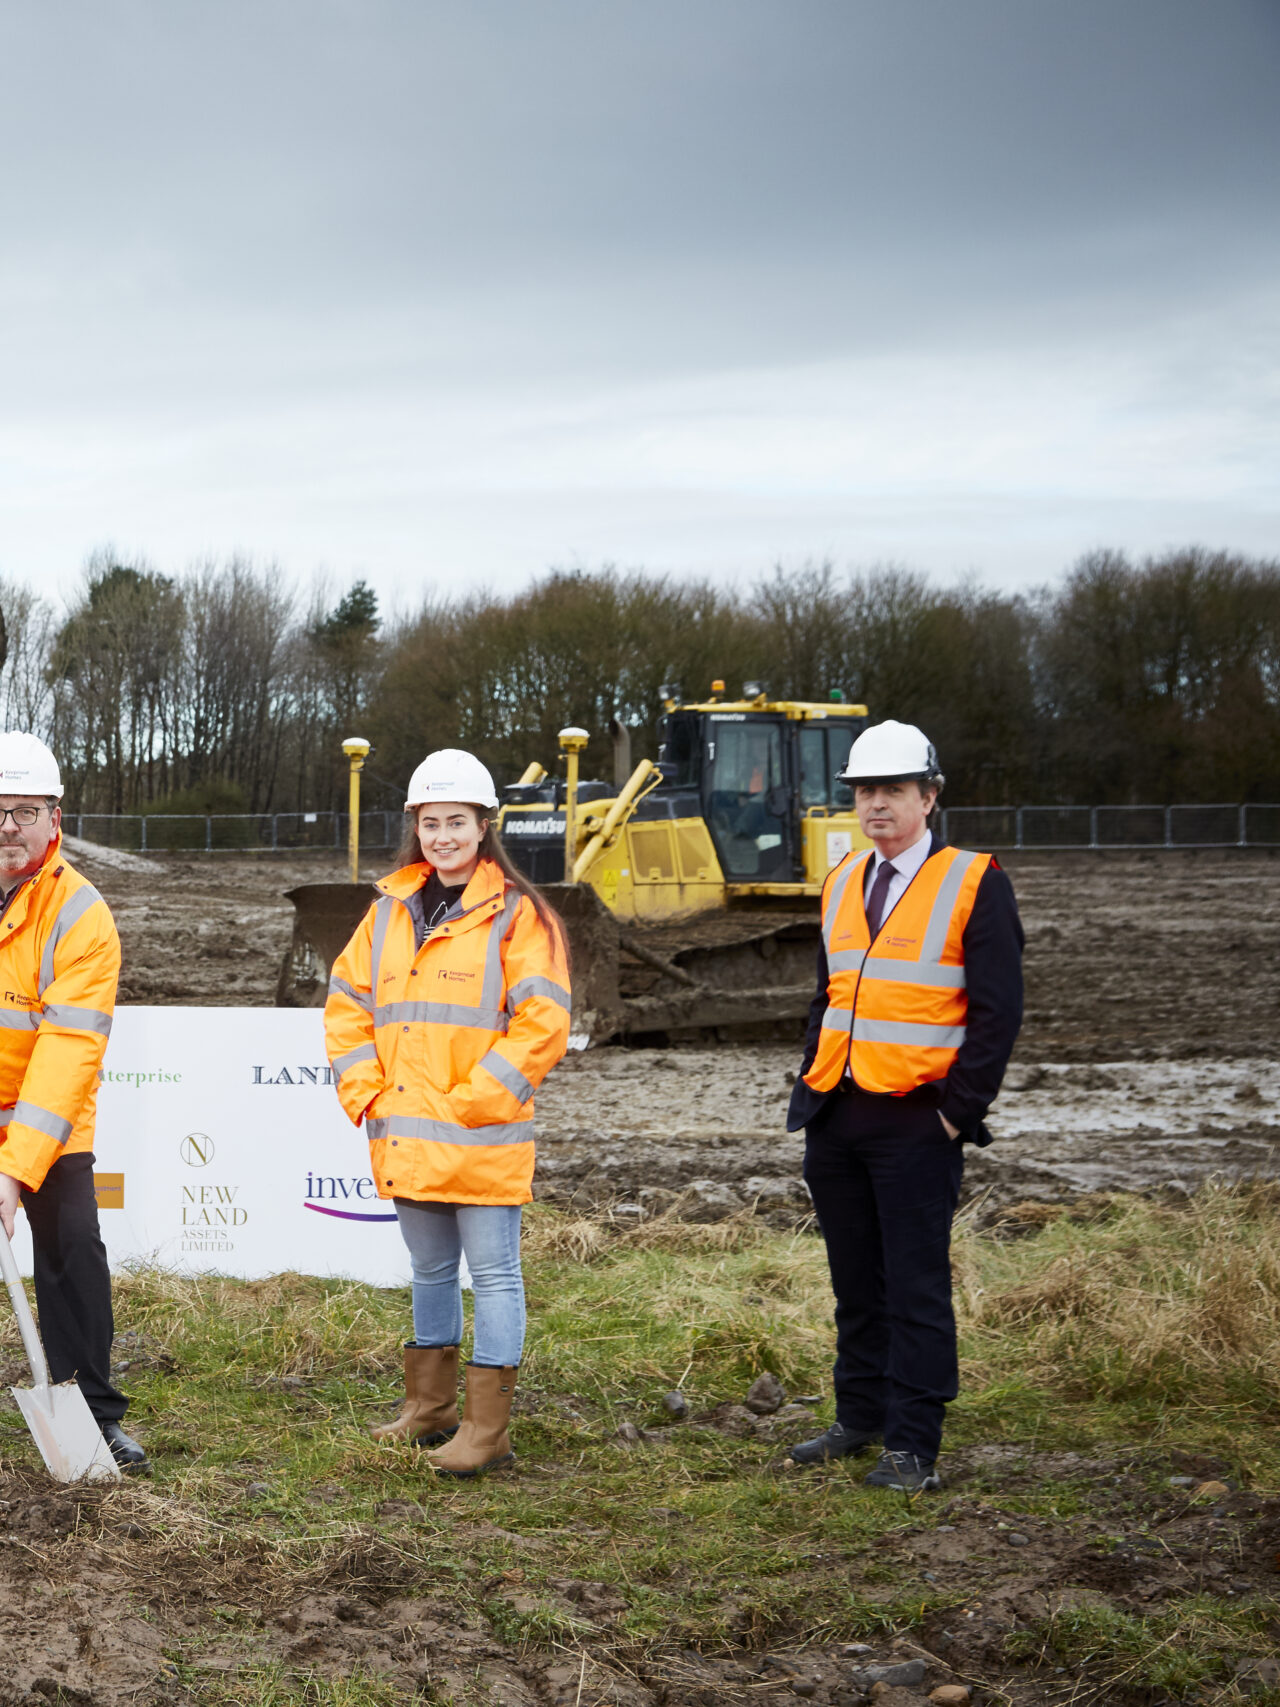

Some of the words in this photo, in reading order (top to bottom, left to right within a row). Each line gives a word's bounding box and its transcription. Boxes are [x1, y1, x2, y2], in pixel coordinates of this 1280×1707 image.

[505, 817, 567, 834] KOMATSU
[181, 1185, 239, 1204] NEW
[305, 1171, 377, 1200] inve
[180, 1207, 248, 1226] LAND
[182, 1229, 228, 1239] ASSETS
[181, 1241, 234, 1251] LIMITED
